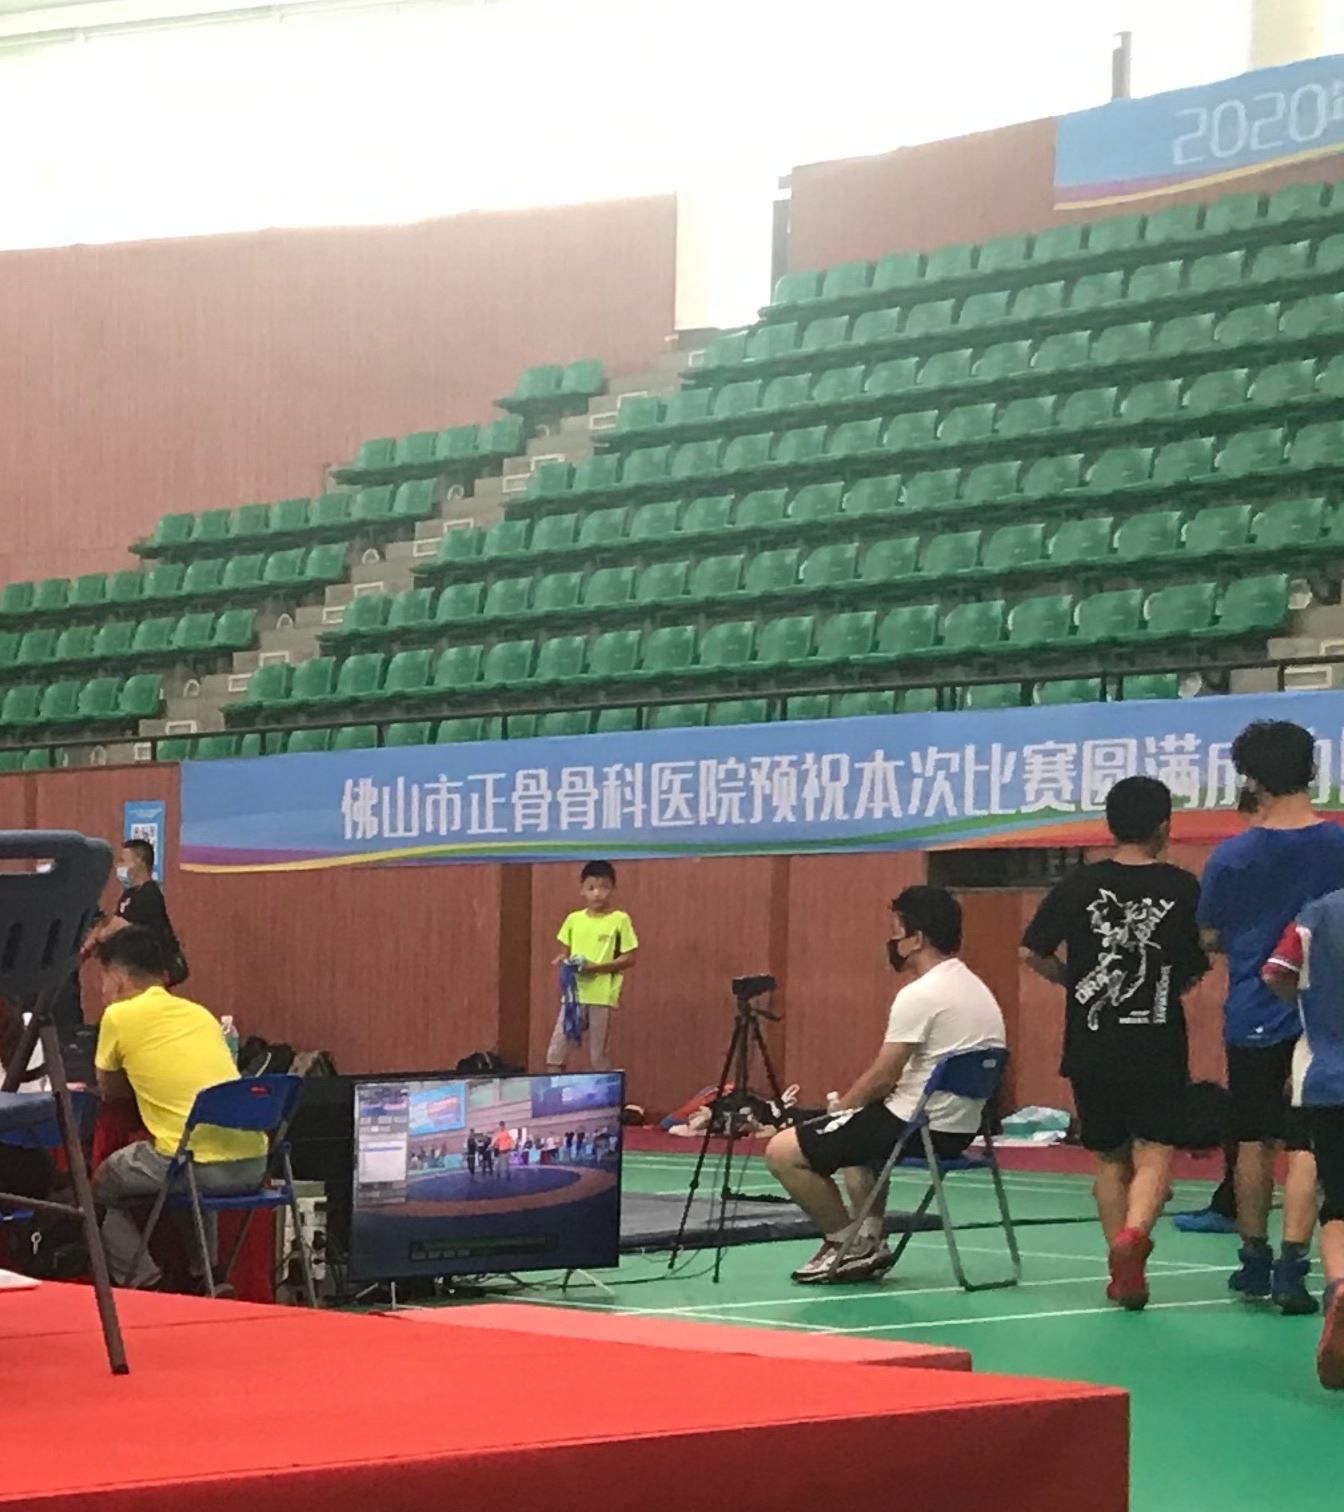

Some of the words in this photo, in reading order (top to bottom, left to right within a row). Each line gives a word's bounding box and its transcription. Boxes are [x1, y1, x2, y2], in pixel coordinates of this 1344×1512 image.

[341, 727, 1344, 841] 佛山市正骨骨科医院预祝本次比赛圆满
